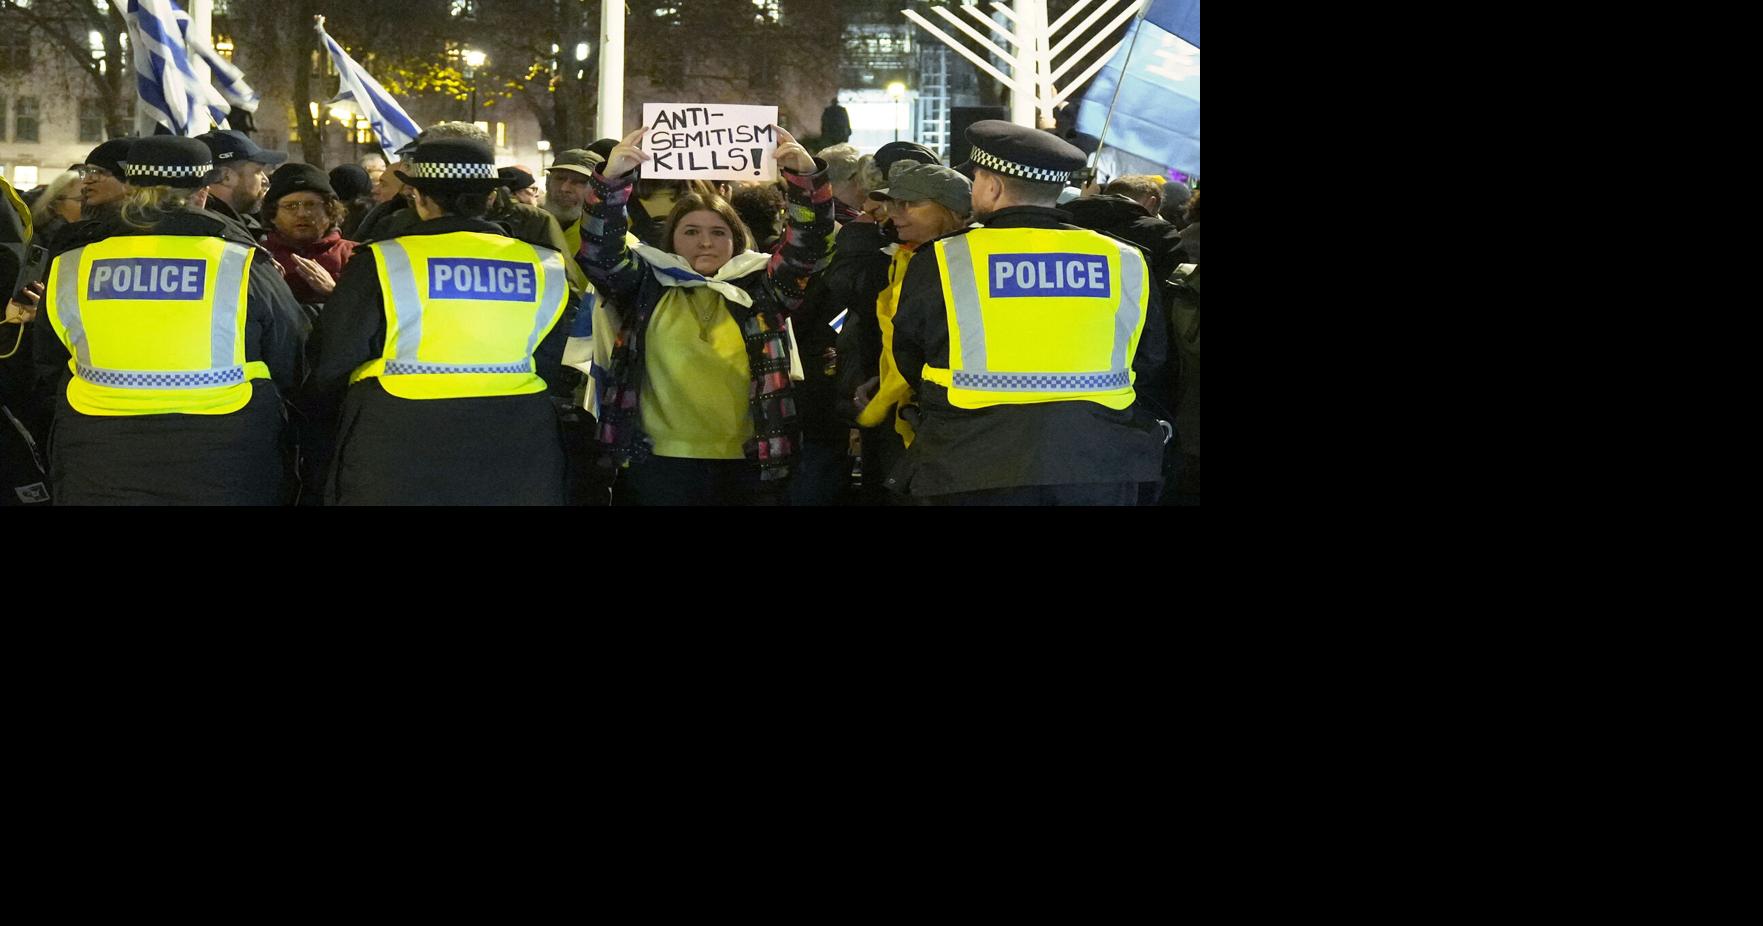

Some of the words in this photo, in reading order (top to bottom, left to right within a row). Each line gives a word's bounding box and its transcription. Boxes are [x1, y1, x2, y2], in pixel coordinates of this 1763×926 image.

[651, 107, 724, 131] ANTI-
[651, 124, 772, 151] SEMITISM
[653, 148, 763, 176] KILLS!
[93, 265, 199, 293] POLICE
[434, 264, 532, 294] POLICE
[995, 260, 1105, 290] POLICE
